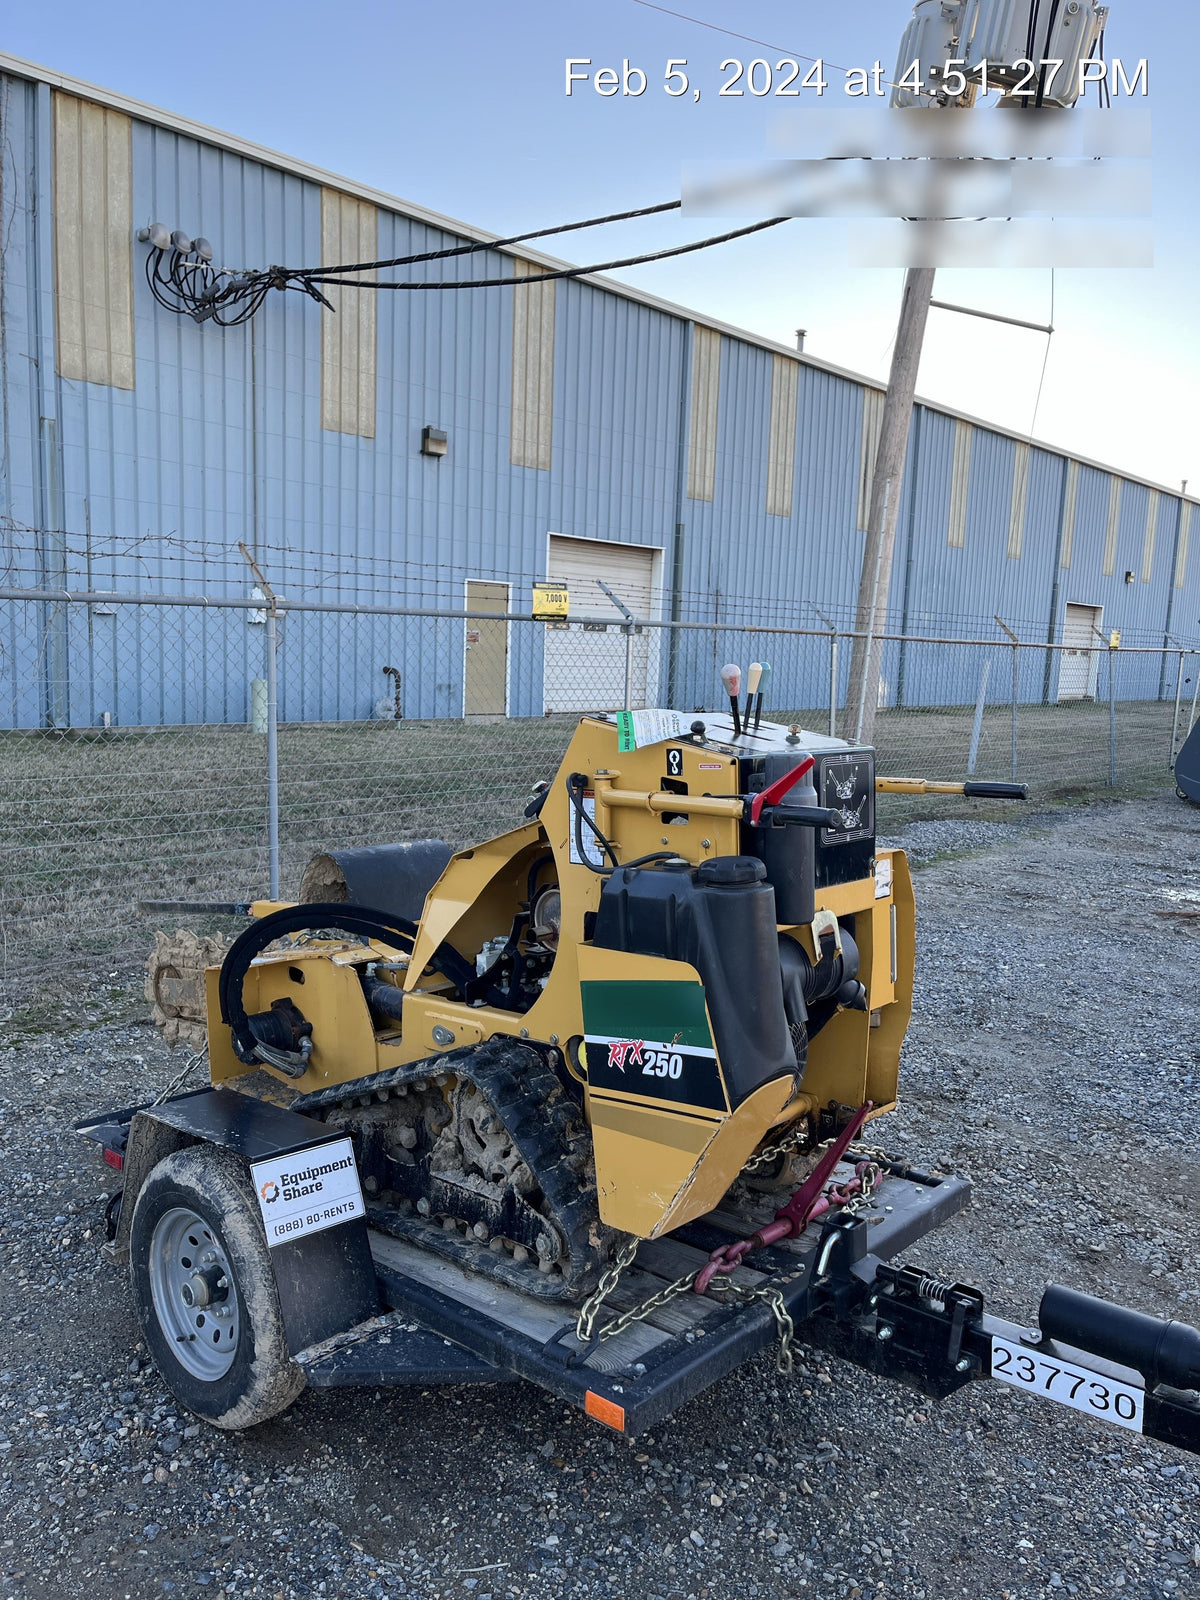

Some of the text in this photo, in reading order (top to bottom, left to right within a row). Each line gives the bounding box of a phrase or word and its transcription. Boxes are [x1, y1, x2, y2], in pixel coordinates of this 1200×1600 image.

[545, 594, 568, 603] 7,000 V
[608, 1039, 683, 1080] RTX 250
[280, 1156, 353, 1187] Equipment
[282, 1181, 323, 1202] Share
[274, 1201, 355, 1237] (888) 80-RENTS
[993, 1346, 1137, 1420] 237730
